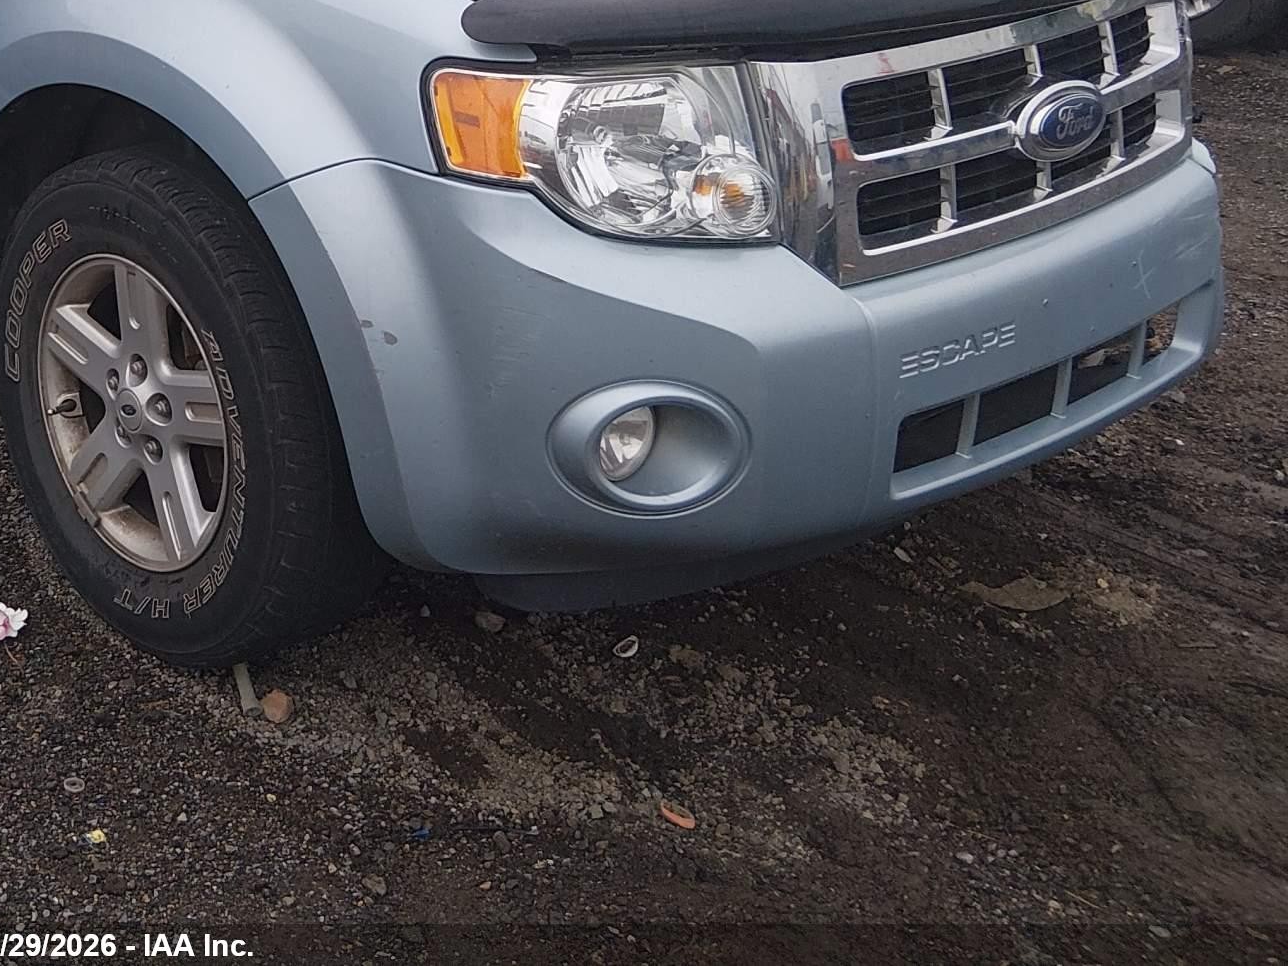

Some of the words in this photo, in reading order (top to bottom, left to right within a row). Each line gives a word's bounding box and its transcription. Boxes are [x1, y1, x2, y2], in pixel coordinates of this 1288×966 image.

[1055, 102, 1094, 140] Ford
[4, 218, 72, 382] COOPER
[898, 323, 1017, 380] ESCAPE
[182, 328, 247, 615] ADVENTURER
[112, 588, 170, 619] H/T
